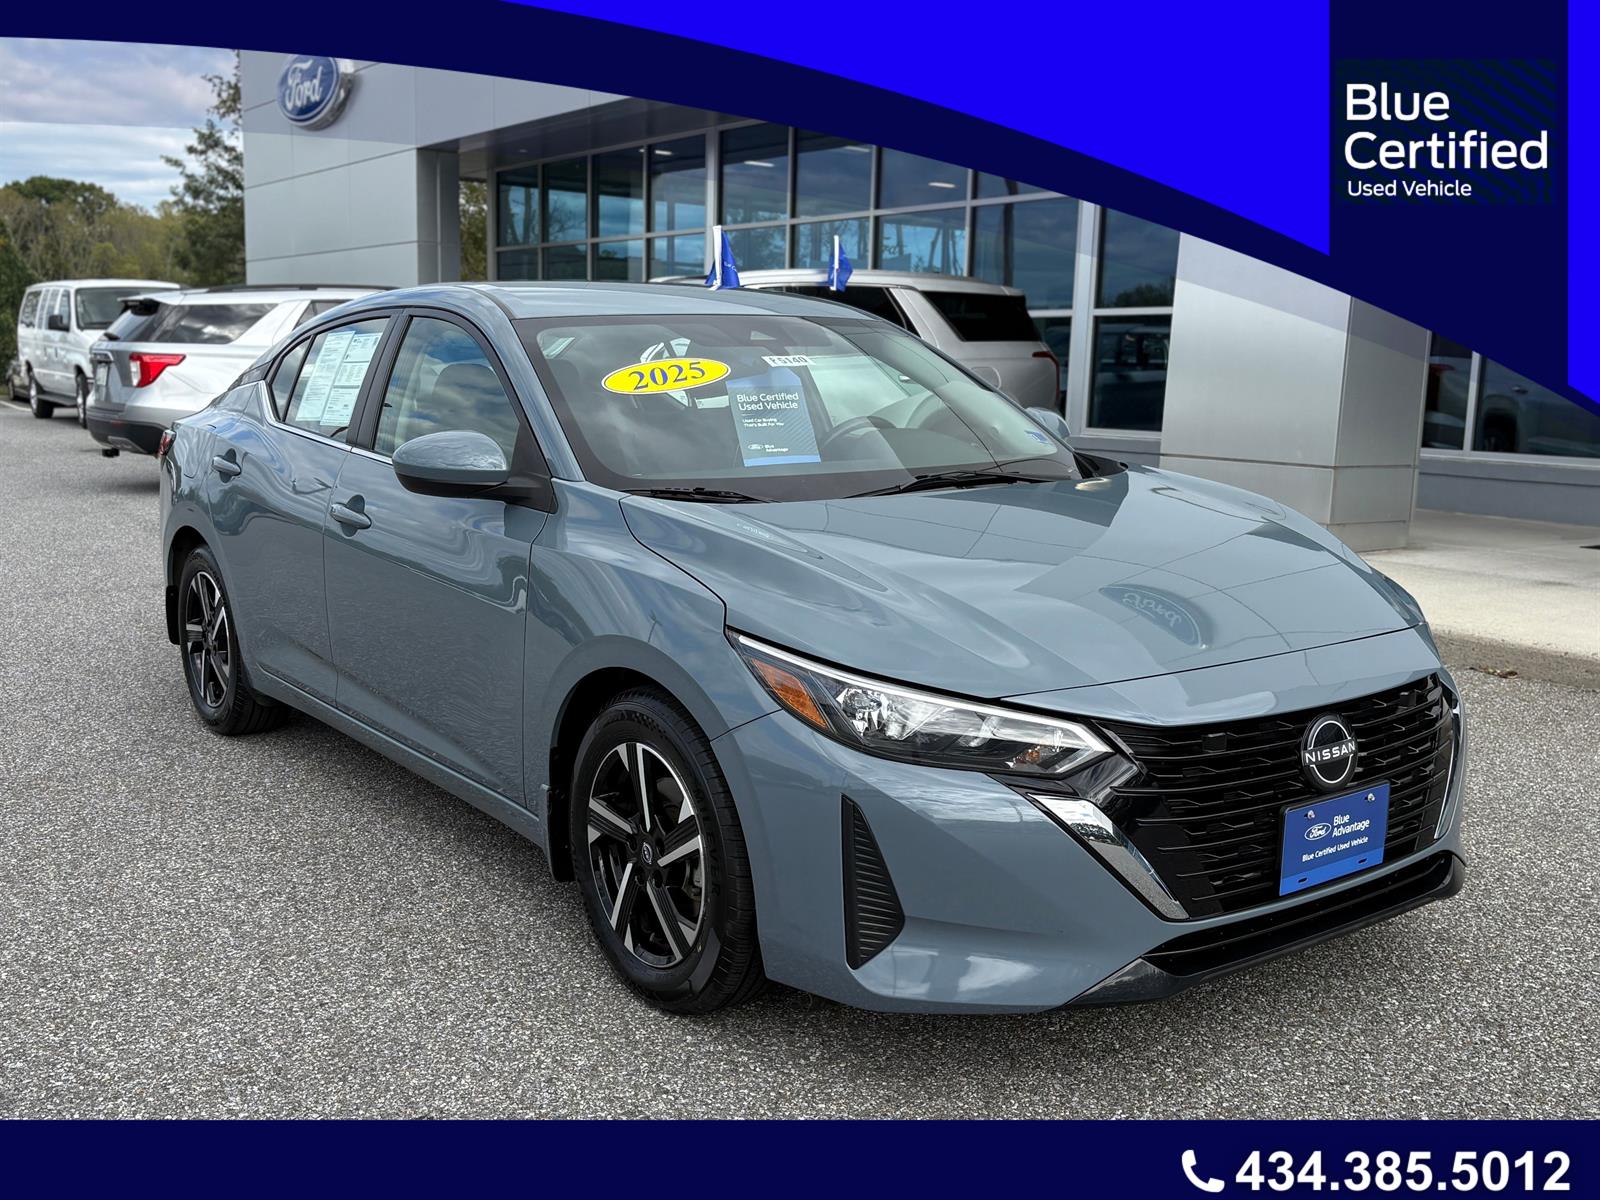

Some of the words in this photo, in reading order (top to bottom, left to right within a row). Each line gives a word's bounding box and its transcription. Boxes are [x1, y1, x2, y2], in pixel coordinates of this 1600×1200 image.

[285, 59, 322, 111] Ford
[628, 361, 706, 391] 2025
[736, 394, 758, 403] Blue
[759, 392, 799, 401] Certified
[738, 402, 763, 411] Used
[764, 401, 798, 410] Vehicle
[1305, 741, 1355, 763] NISSAN
[1332, 819, 1370, 838] Advantage
[1333, 814, 1350, 826] Blue
[1302, 852, 1315, 862] Blue
[1315, 845, 1337, 858] Certified
[1337, 841, 1350, 852] Used
[1351, 836, 1369, 847] Vehicle
